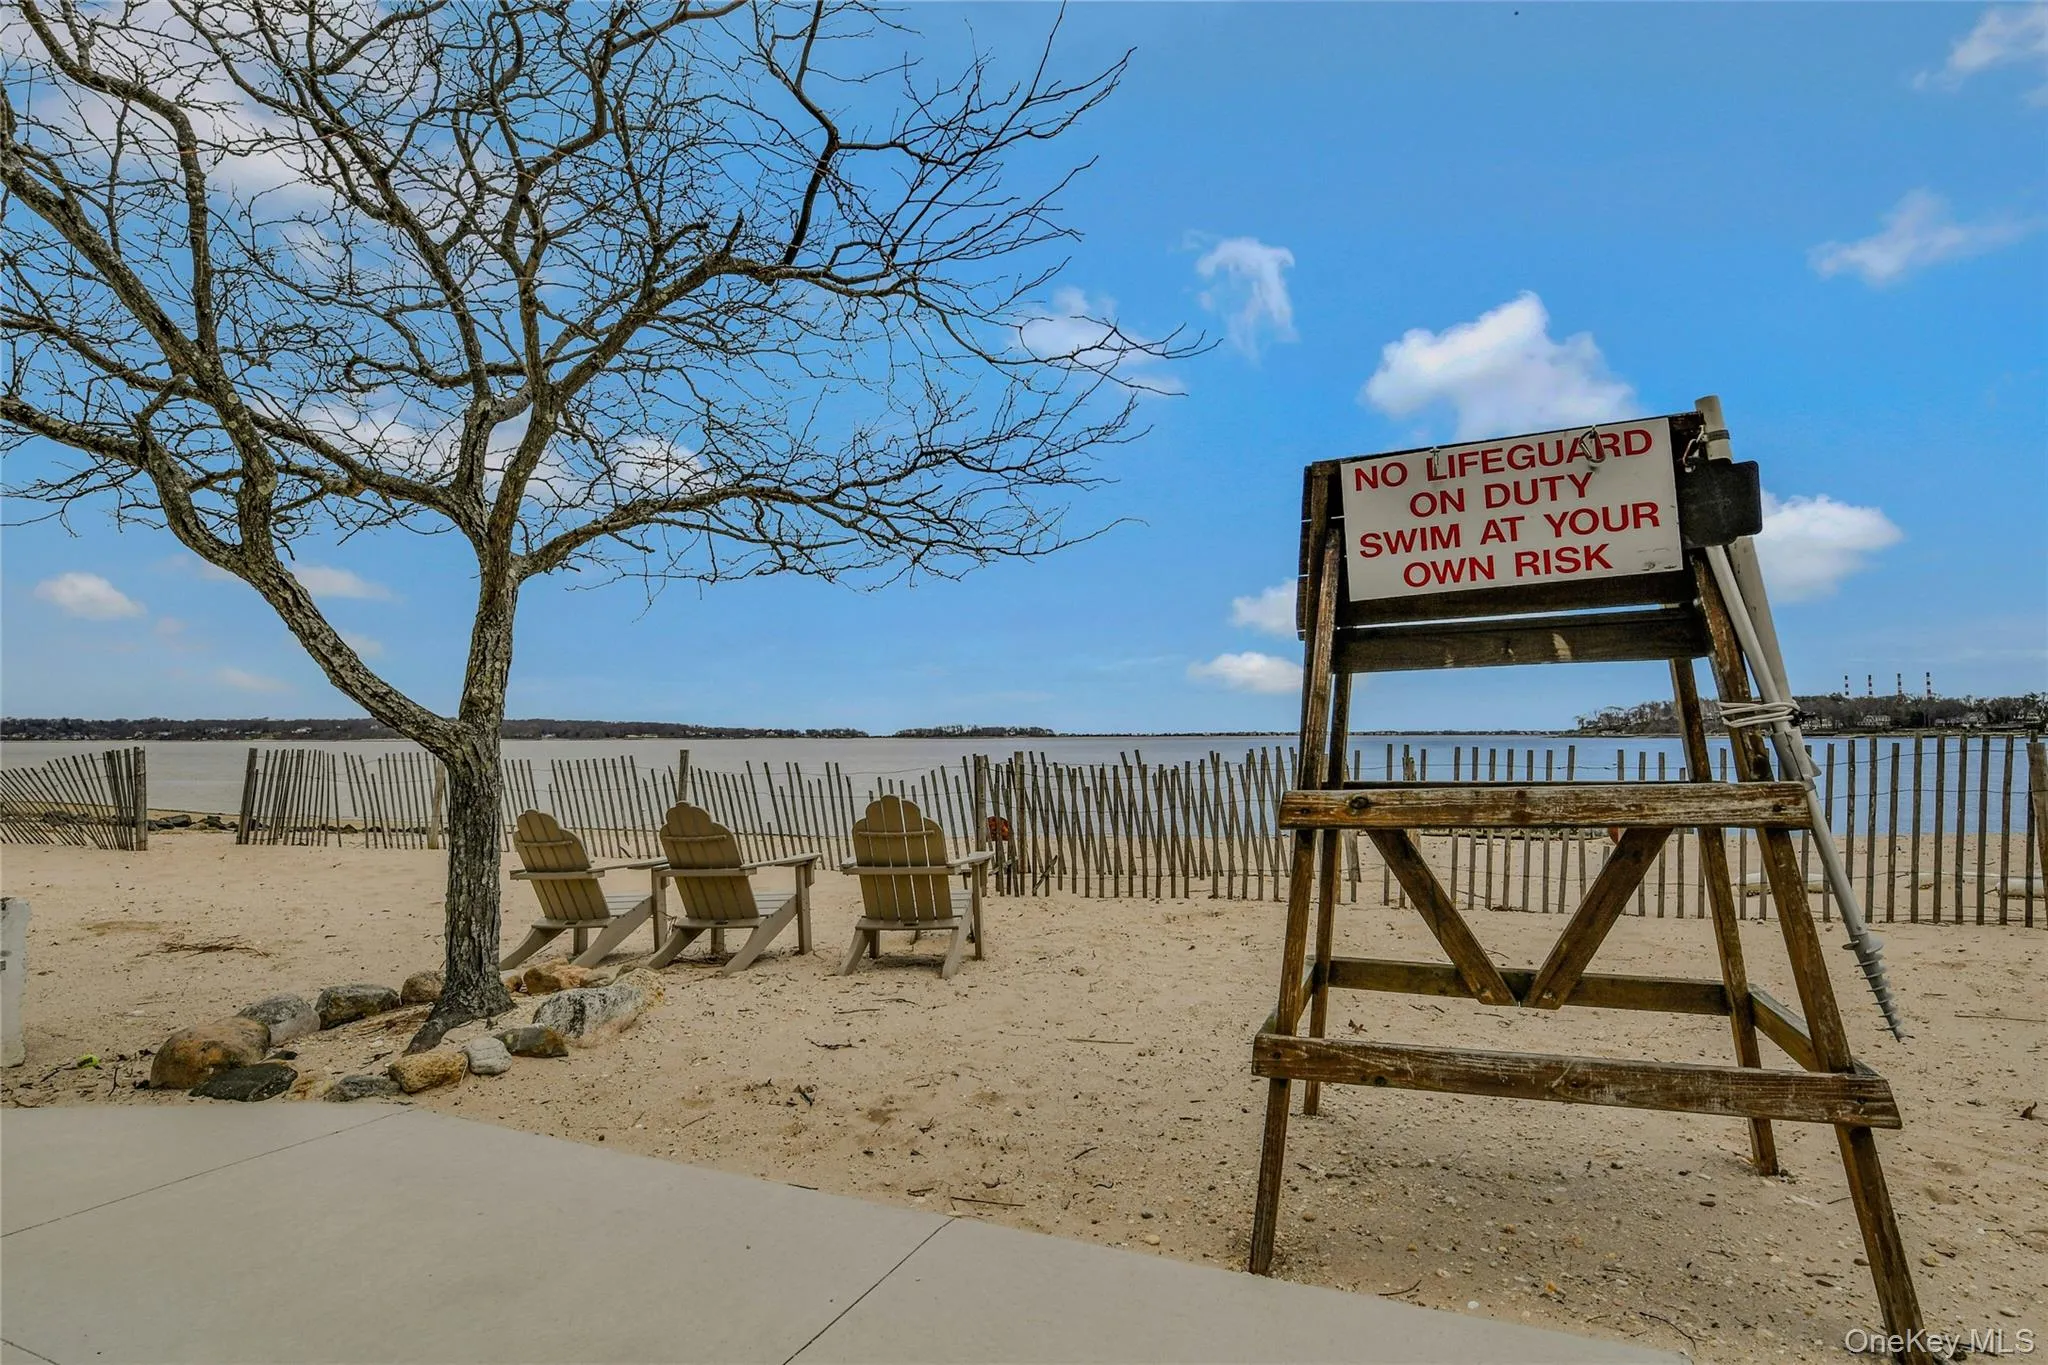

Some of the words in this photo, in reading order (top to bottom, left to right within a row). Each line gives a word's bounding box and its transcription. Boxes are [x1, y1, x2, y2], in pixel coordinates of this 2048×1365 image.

[1354, 461, 1408, 492] NO
[1426, 429, 1653, 483] LIFEGUARD
[1409, 488, 1465, 518] ON
[1485, 472, 1593, 509] DUTY
[1359, 523, 1462, 559] SWIM
[1480, 516, 1525, 545] AT
[1544, 501, 1660, 539] YOUR
[1403, 555, 1496, 588] OWN
[1515, 544, 1613, 577] RISK
